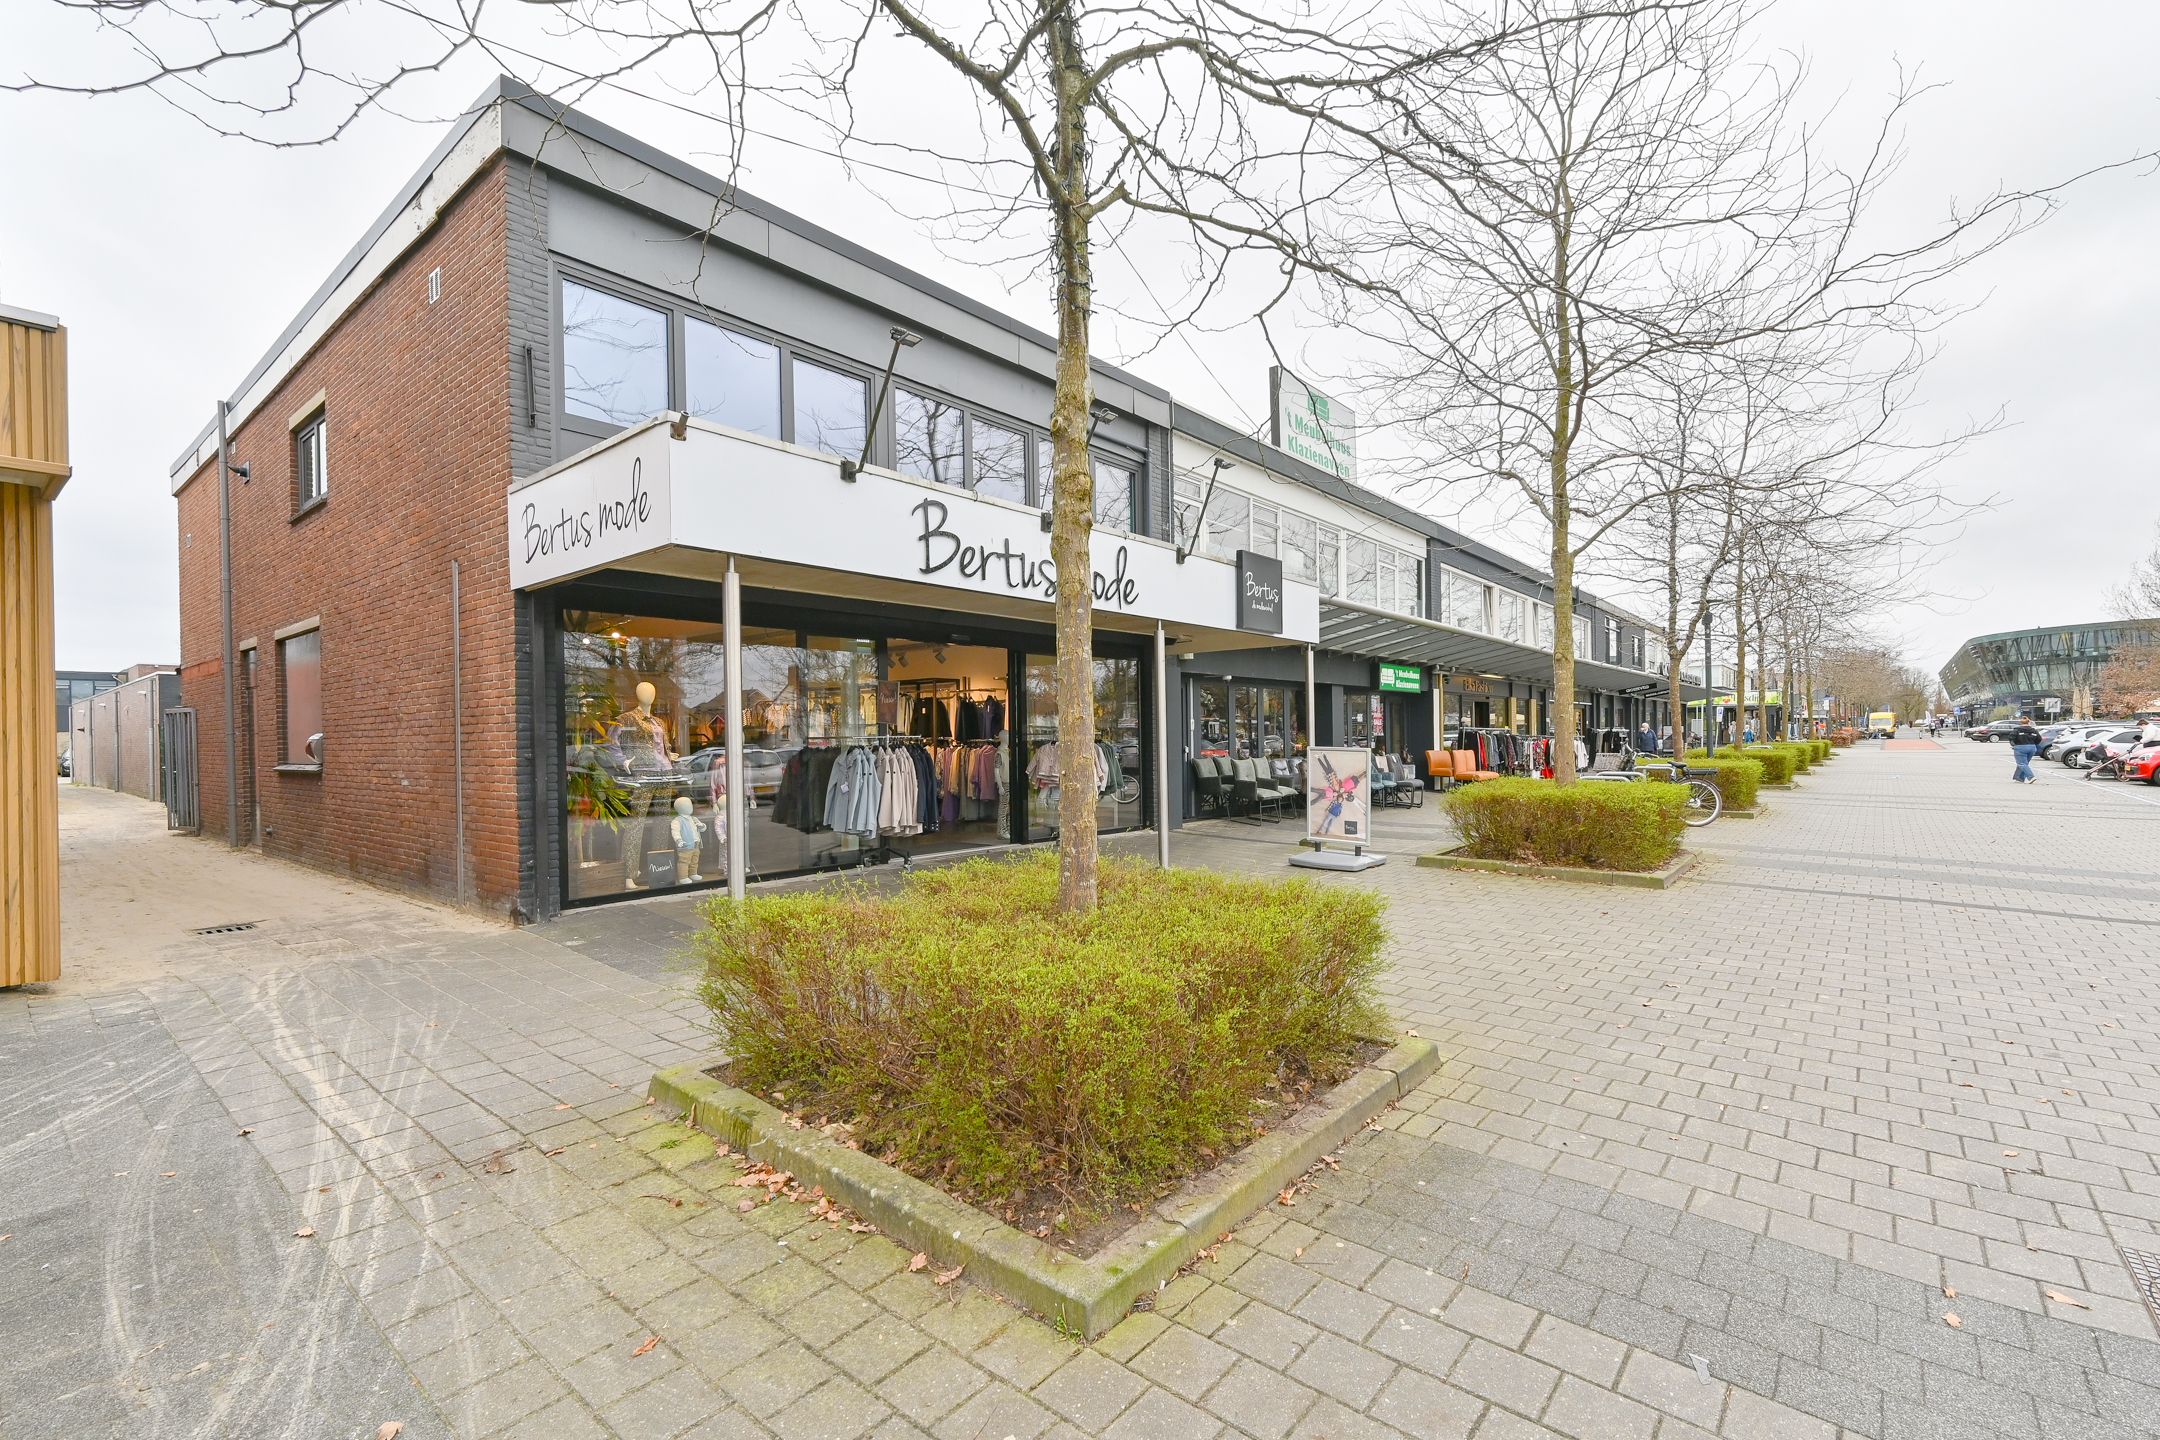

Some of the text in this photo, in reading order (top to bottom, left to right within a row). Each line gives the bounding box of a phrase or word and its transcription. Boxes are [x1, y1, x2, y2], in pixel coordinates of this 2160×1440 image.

[1287, 434, 1350, 478] Klazienaven
[521, 456, 652, 565] Bertus mode
[911, 497, 1140, 610] Bertus ode
[1245, 571, 1280, 604] Bertus
